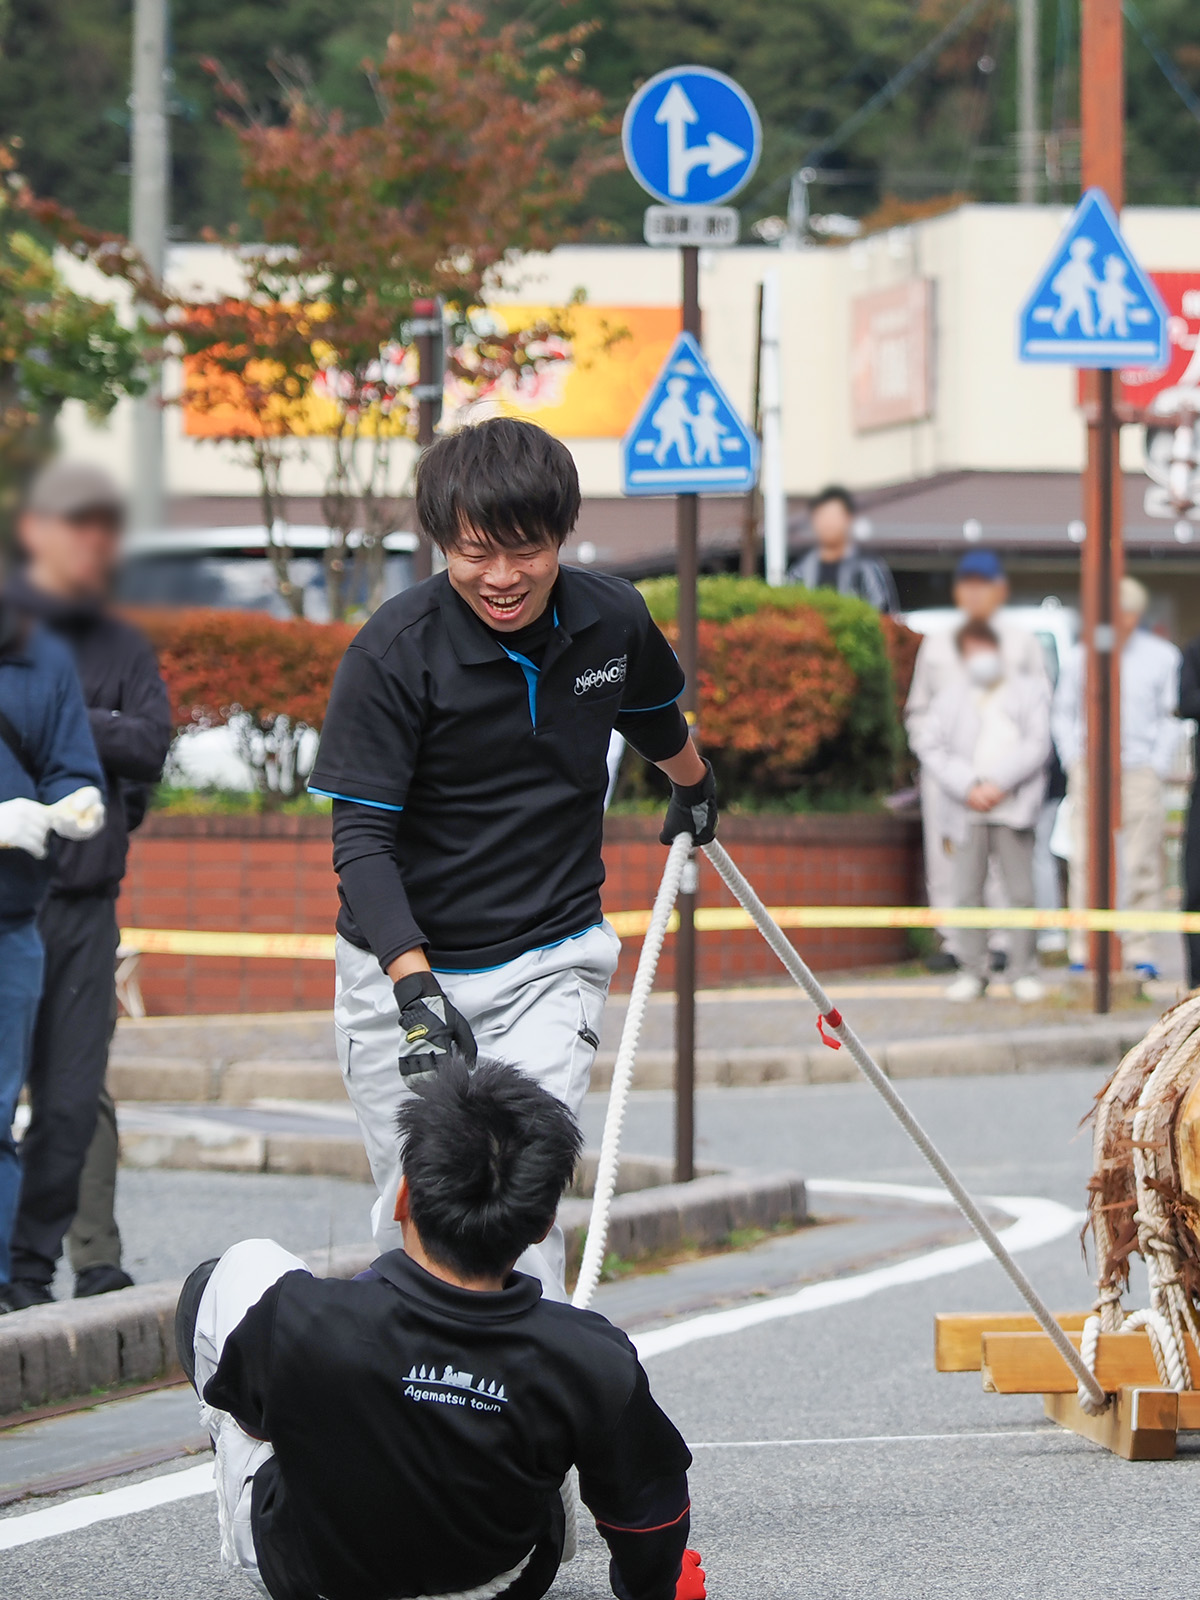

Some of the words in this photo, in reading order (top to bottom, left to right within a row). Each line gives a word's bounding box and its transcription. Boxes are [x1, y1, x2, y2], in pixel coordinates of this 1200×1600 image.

[575, 666, 619, 689] NAGANO
[404, 1384, 466, 1406] Agematsu
[470, 1398, 502, 1412] town
